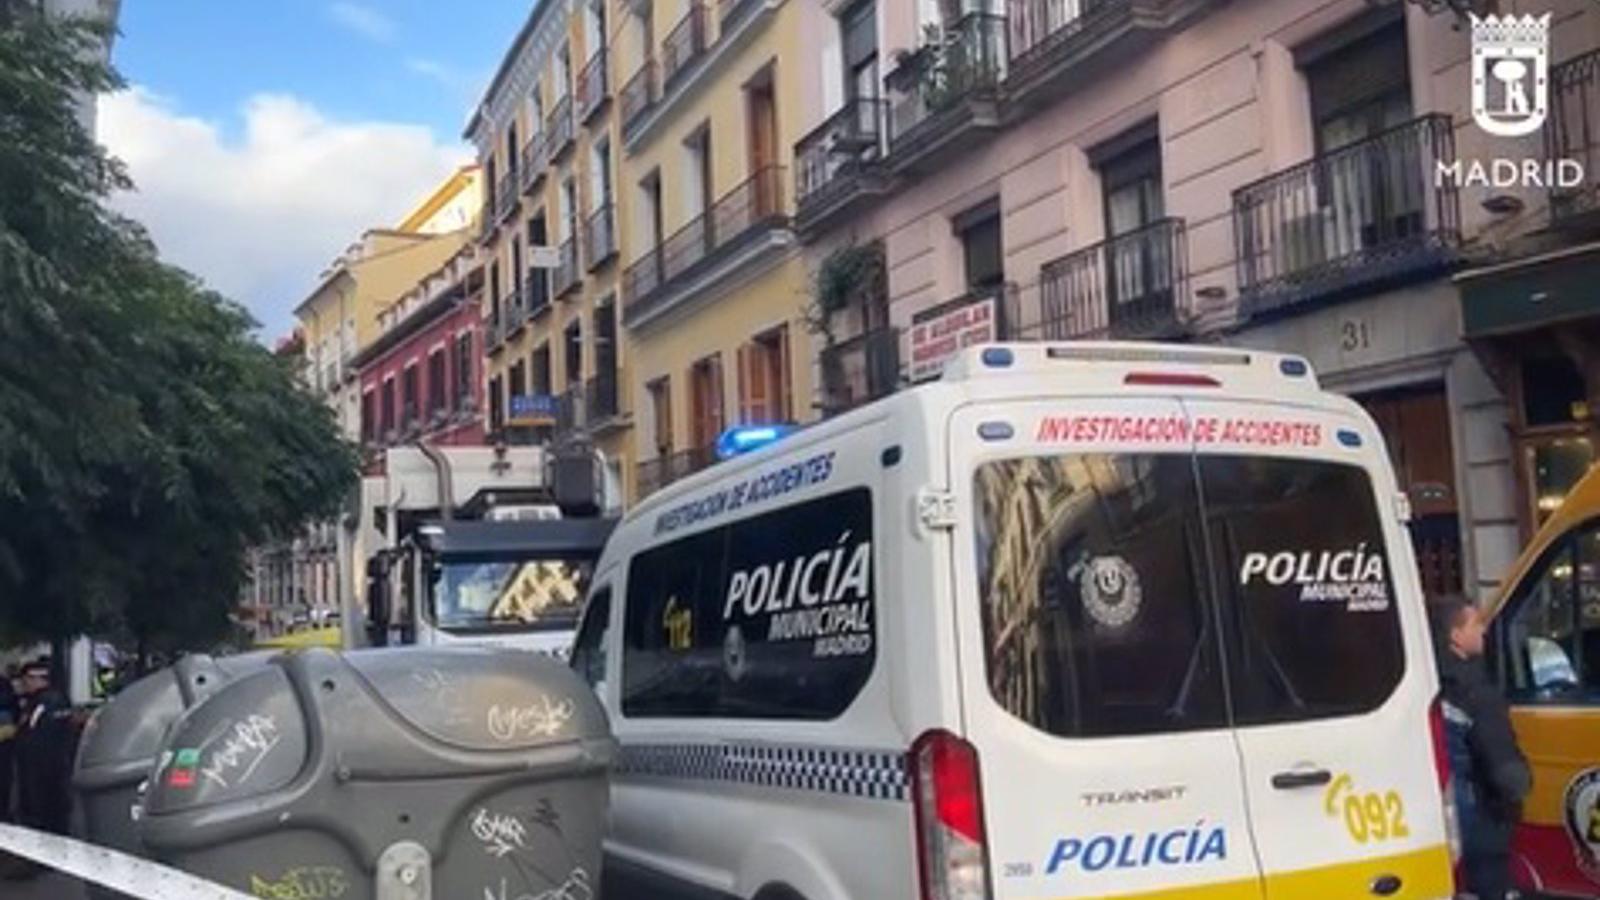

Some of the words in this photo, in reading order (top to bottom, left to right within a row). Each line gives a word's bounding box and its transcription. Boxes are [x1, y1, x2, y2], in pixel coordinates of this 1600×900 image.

[1343, 320, 1369, 352] 31
[1037, 411, 1188, 443] INVESTIGACIÓN
[1193, 416, 1218, 443] DE
[1220, 417, 1322, 447] ACCIDENTES
[723, 529, 871, 620] POLICÍA
[1240, 542, 1384, 585] POLICÍA
[1300, 582, 1387, 602] MUNICIPAL
[768, 601, 871, 642] MUNICIPAL
[813, 633, 871, 658] MADRID
[1081, 786, 1187, 807] TRANSIT
[1344, 789, 1409, 844] 092
[1045, 819, 1227, 875] POLICÍA
